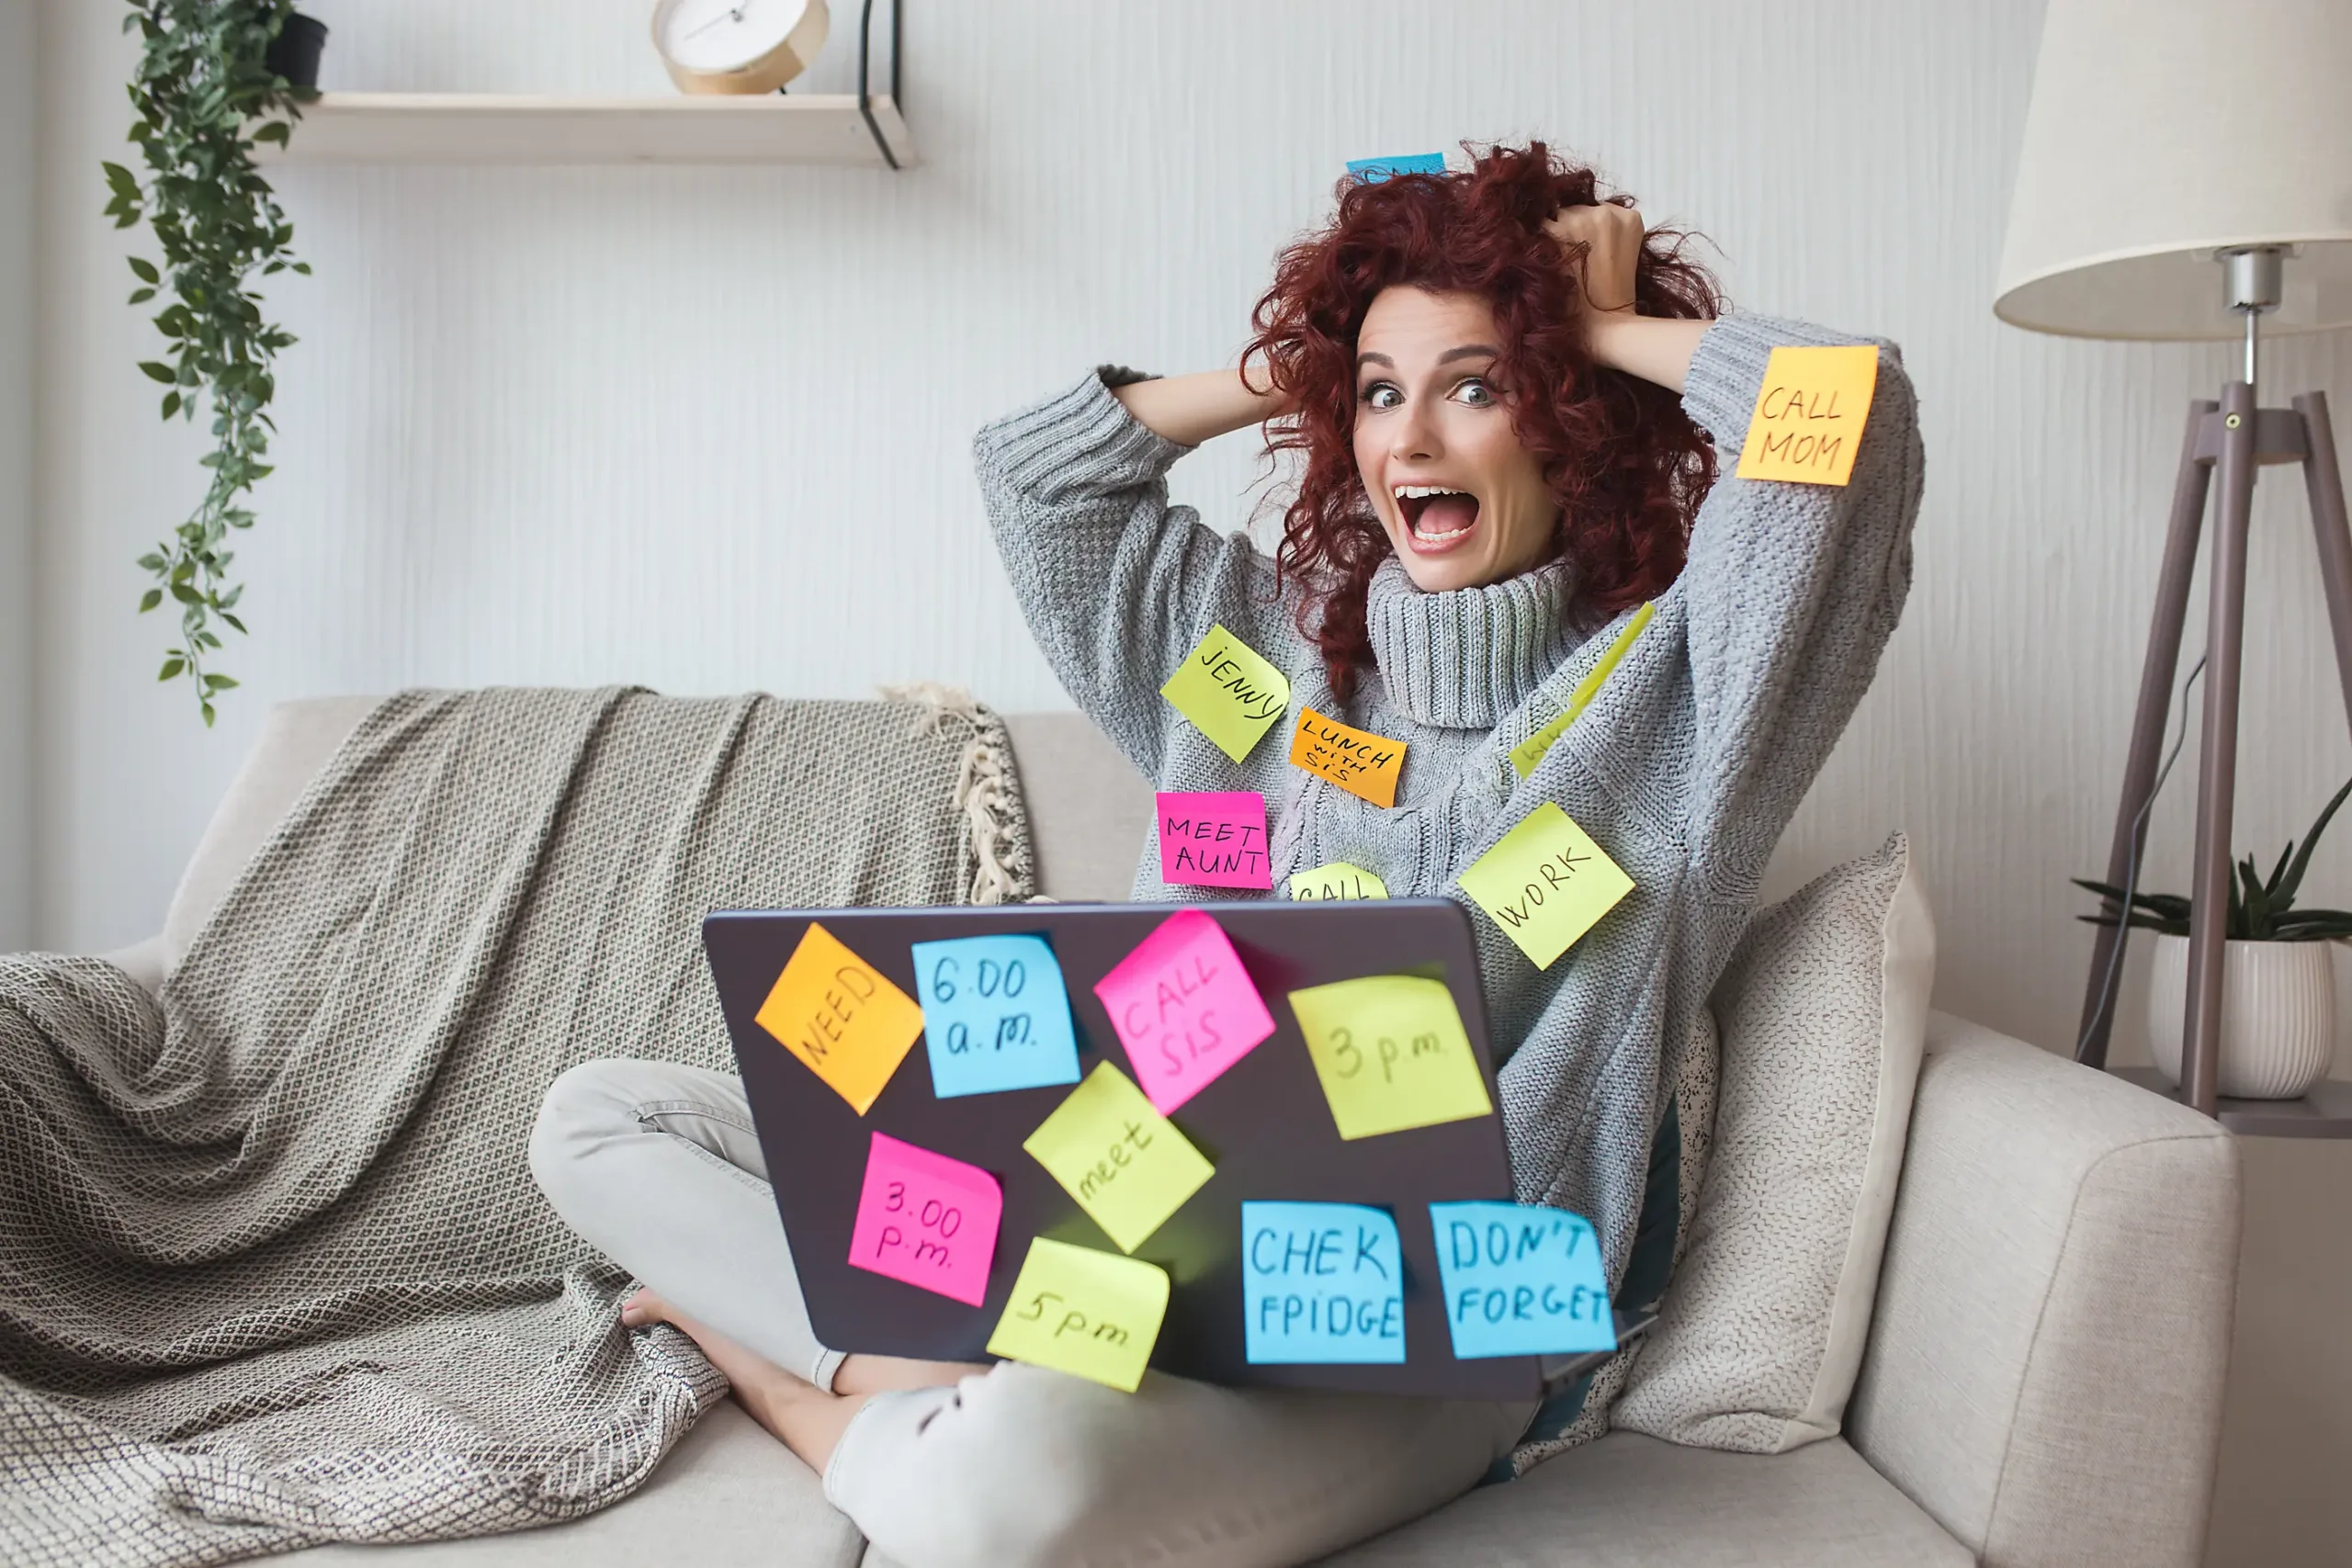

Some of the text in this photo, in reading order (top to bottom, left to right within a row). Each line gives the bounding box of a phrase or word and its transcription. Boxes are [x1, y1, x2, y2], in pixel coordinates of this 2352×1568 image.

[1762, 387, 1841, 421] CALL
[1759, 431, 1842, 471] MOM
[1302, 720, 1394, 769] LUNCH
[1167, 817, 1261, 847] MEET
[1176, 846, 1264, 875] AUNT
[1496, 846, 1592, 928] WORK
[933, 956, 1026, 1004] 6.00
[1124, 955, 1220, 1041] CALL
[801, 965, 876, 1066] NEED
[1329, 1025, 1363, 1079] 3
[1079, 1120, 1154, 1201] meet
[885, 1181, 962, 1239] 3.00
[1251, 1224, 1389, 1280] CHEK
[1450, 1220, 1586, 1271] DON'T
[1016, 1291, 1064, 1321] 5
[1457, 1284, 1608, 1325] FORGET
